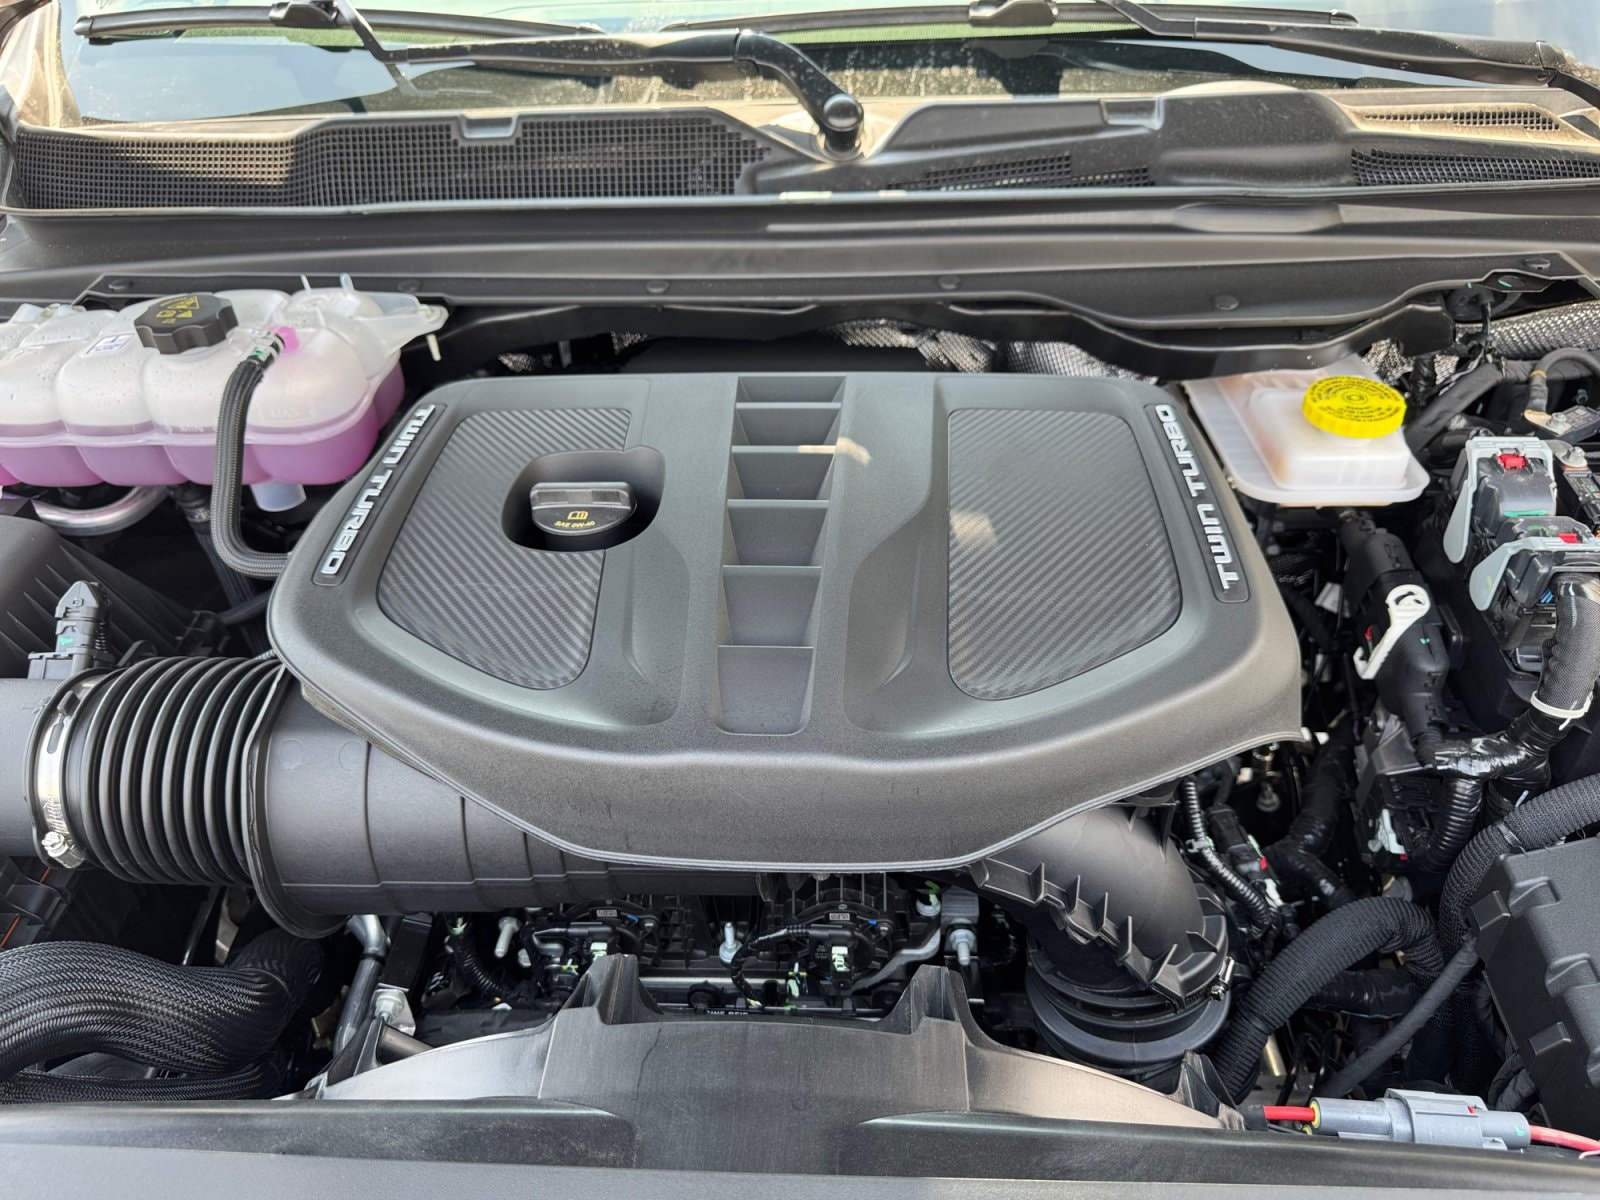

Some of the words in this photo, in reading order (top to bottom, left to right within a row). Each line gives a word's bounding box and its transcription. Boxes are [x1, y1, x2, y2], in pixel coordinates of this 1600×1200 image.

[382, 404, 436, 464] TWIN
[1155, 404, 1207, 497] TURBO
[320, 469, 393, 575] TURBO
[1196, 503, 1240, 590] TWIN
